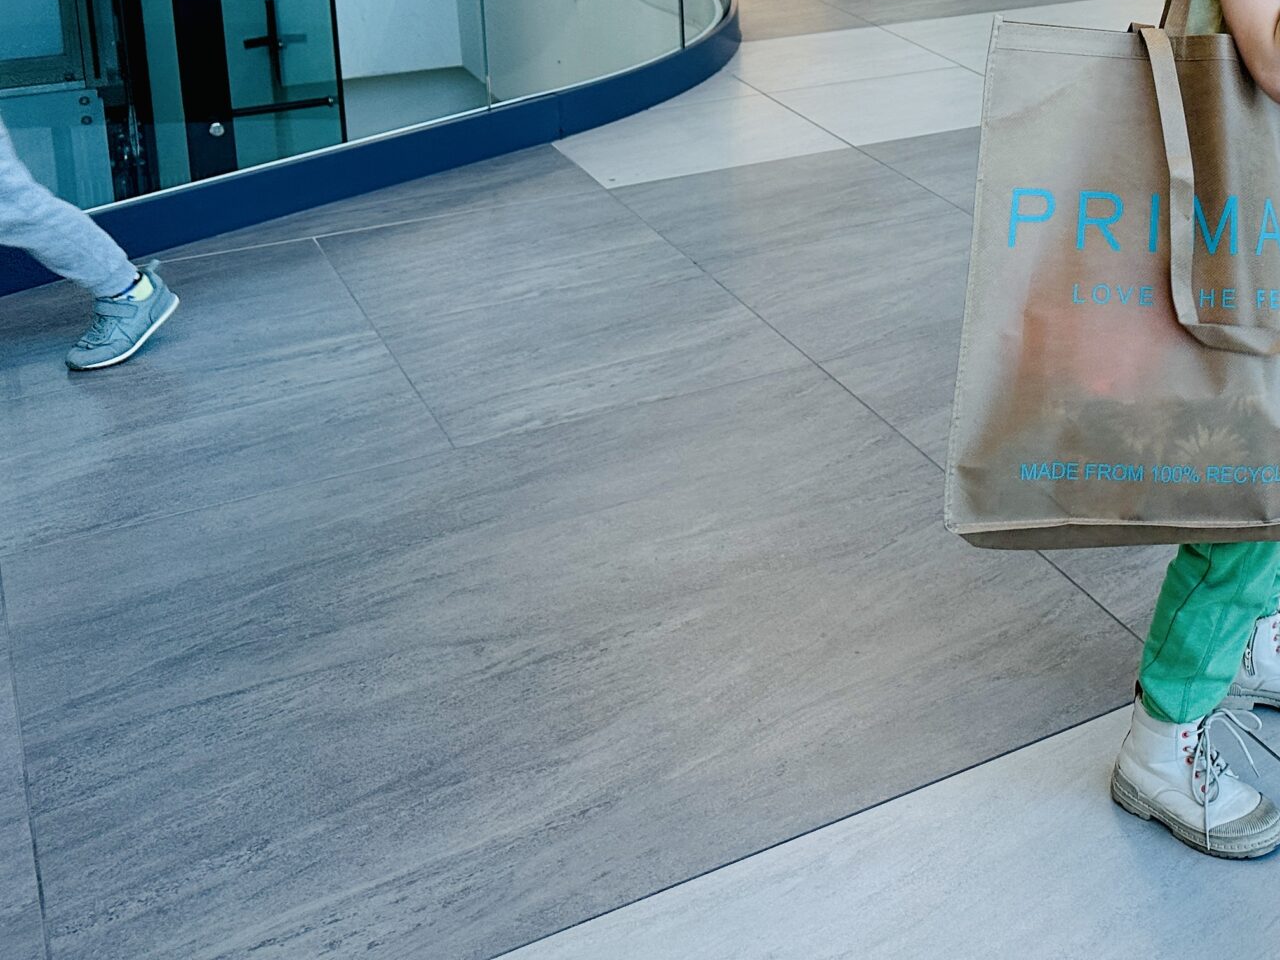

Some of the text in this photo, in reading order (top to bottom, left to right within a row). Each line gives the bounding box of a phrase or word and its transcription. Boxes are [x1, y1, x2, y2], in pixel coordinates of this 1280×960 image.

[1071, 282, 1154, 307] LOVE
[1199, 288, 1237, 309] HE
[1020, 462, 1079, 481] MADE
[1084, 463, 1144, 482] FROM
[1151, 464, 1201, 484] 100%
